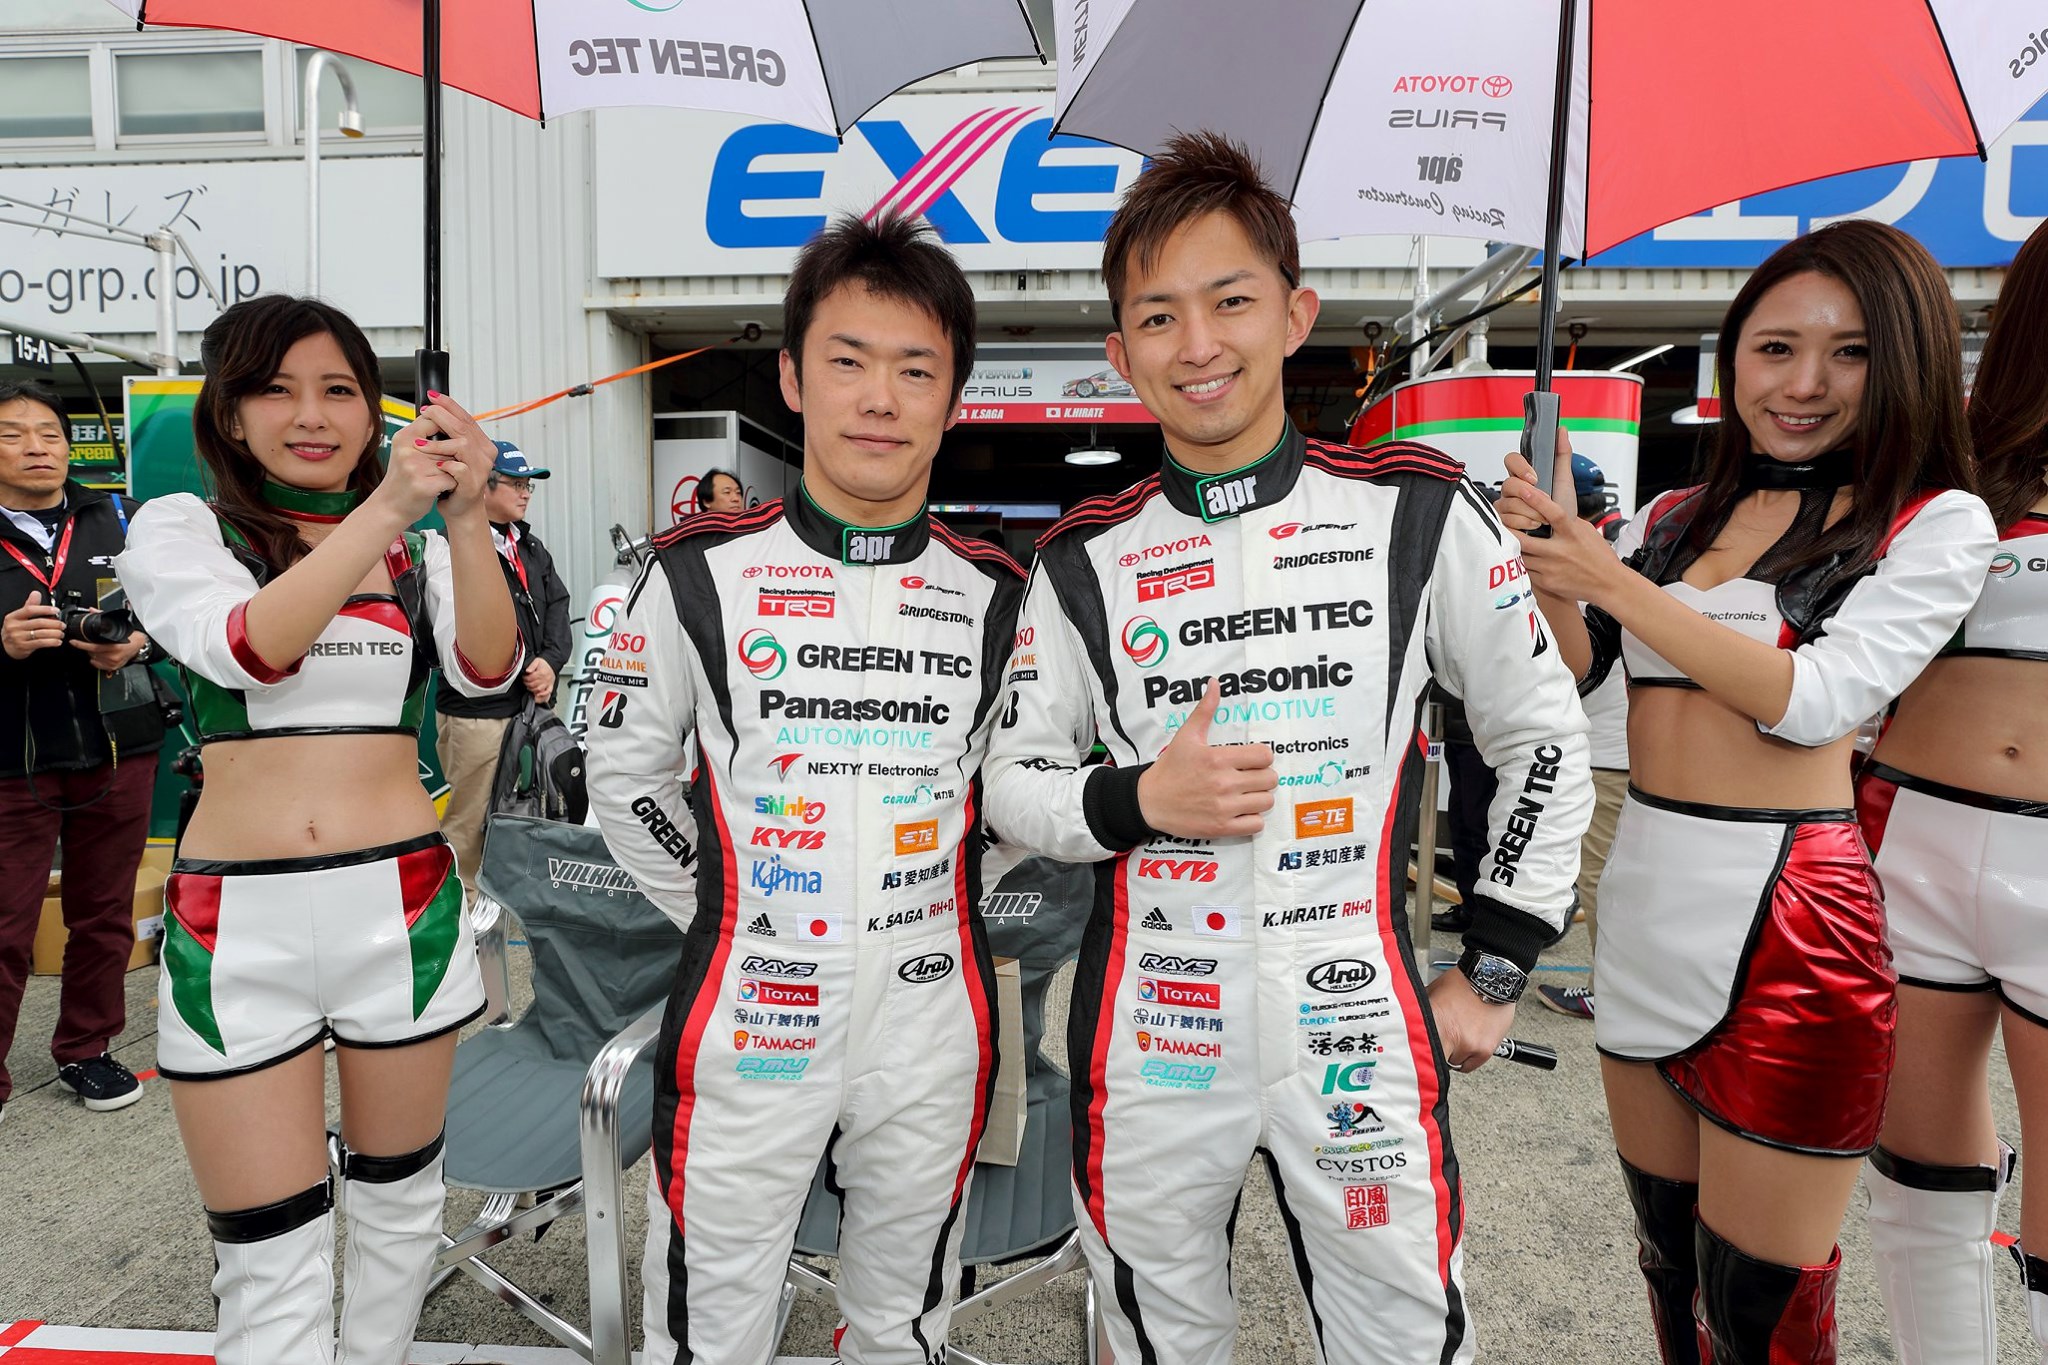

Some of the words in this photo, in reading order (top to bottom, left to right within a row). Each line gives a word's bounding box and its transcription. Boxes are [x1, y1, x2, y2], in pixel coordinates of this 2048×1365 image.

[16, 334, 49, 364] 15-A
[965, 386, 1033, 397] PRIUS
[971, 409, 1004, 420] K.SAGA
[1064, 407, 1104, 418] K.HIRATE
[1142, 534, 1212, 560] TOYOTA
[1136, 570, 1163, 579] Racing
[1164, 558, 1214, 574] Development
[1273, 548, 1374, 570] BRIDGESTONE
[765, 565, 834, 579] TOYOTA
[759, 587, 785, 595] Racing
[786, 589, 835, 597] Development
[1141, 570, 1211, 598] TRD
[762, 599, 831, 617] TRD
[899, 603, 974, 628] BRIDGESTONE
[1179, 606, 1297, 647] GREEN
[1303, 600, 1374, 631] TEC
[366, 641, 404, 656] TEC
[626, 660, 647, 673] MIE
[919, 651, 973, 678] TEC
[628, 678, 645, 686] MIE
[760, 690, 950, 725] Panasonic
[1165, 696, 1336, 732] AOMOTIVE
[776, 727, 932, 748] AUTOMOTIVE
[869, 763, 939, 777] Electronics
[1278, 774, 1323, 786] CORUN
[1490, 795, 1545, 888] GREEN
[1523, 744, 1563, 794] TEC
[631, 796, 698, 869] GREEN
[750, 827, 826, 850] KYB
[1305, 844, 1367, 868] 愛知産業
[904, 859, 949, 886] 愛知産業
[1138, 858, 1219, 882] KYB
[867, 908, 923, 932] K.SAGA
[1141, 920, 1173, 931] adidas
[747, 925, 777, 937] adidas
[741, 956, 818, 976] RAYS
[903, 955, 949, 976] Arai
[1139, 953, 1218, 974] RAYS
[1312, 963, 1370, 984] Arai
[749, 1012, 821, 1027] 山下製作所
[1150, 1013, 1223, 1031] 山下製作所
[752, 1035, 816, 1050] TAMACHI
[1154, 1038, 1221, 1057] TAMACHI
[1146, 1079, 1182, 1089] RACING
[1316, 1152, 1407, 1173] CVSTOS
